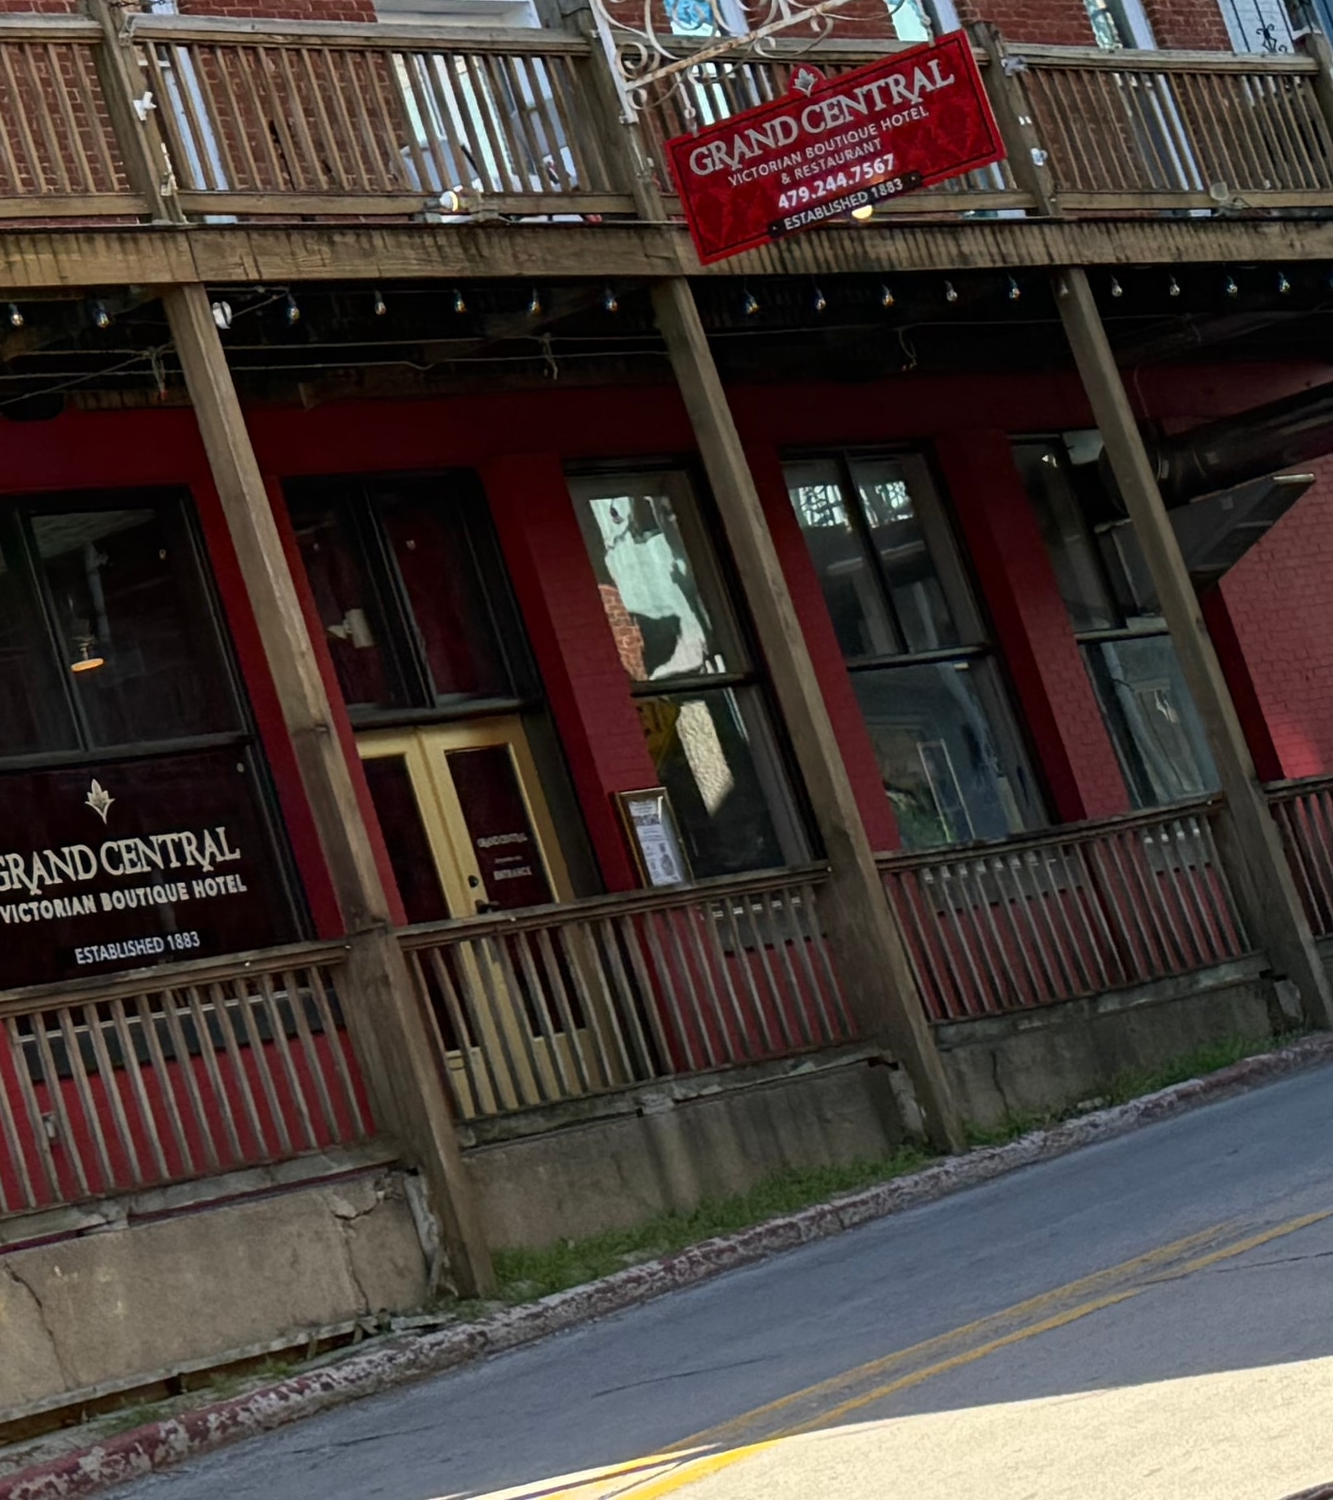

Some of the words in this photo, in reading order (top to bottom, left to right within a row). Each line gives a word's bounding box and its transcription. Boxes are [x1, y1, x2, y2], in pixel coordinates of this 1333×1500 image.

[689, 114, 799, 177] GRAND
[801, 59, 955, 134] CENTRAL
[728, 150, 802, 187] VICTORIAN
[806, 122, 878, 159] BOUTIQUE
[881, 104, 929, 132] HOTEL
[780, 170, 792, 185] &
[794, 137, 883, 179] RESTAURANT
[778, 152, 895, 209] 479.244.7567
[783, 189, 869, 231] ESTABLISHED
[871, 177, 904, 201] 1883
[100, 826, 241, 876] CENTRAL
[101, 882, 190, 911] BOUTIQUE
[193, 874, 248, 899] HOTEL
[74, 936, 165, 965] ESTABLISHED
[167, 931, 201, 951] 1883
